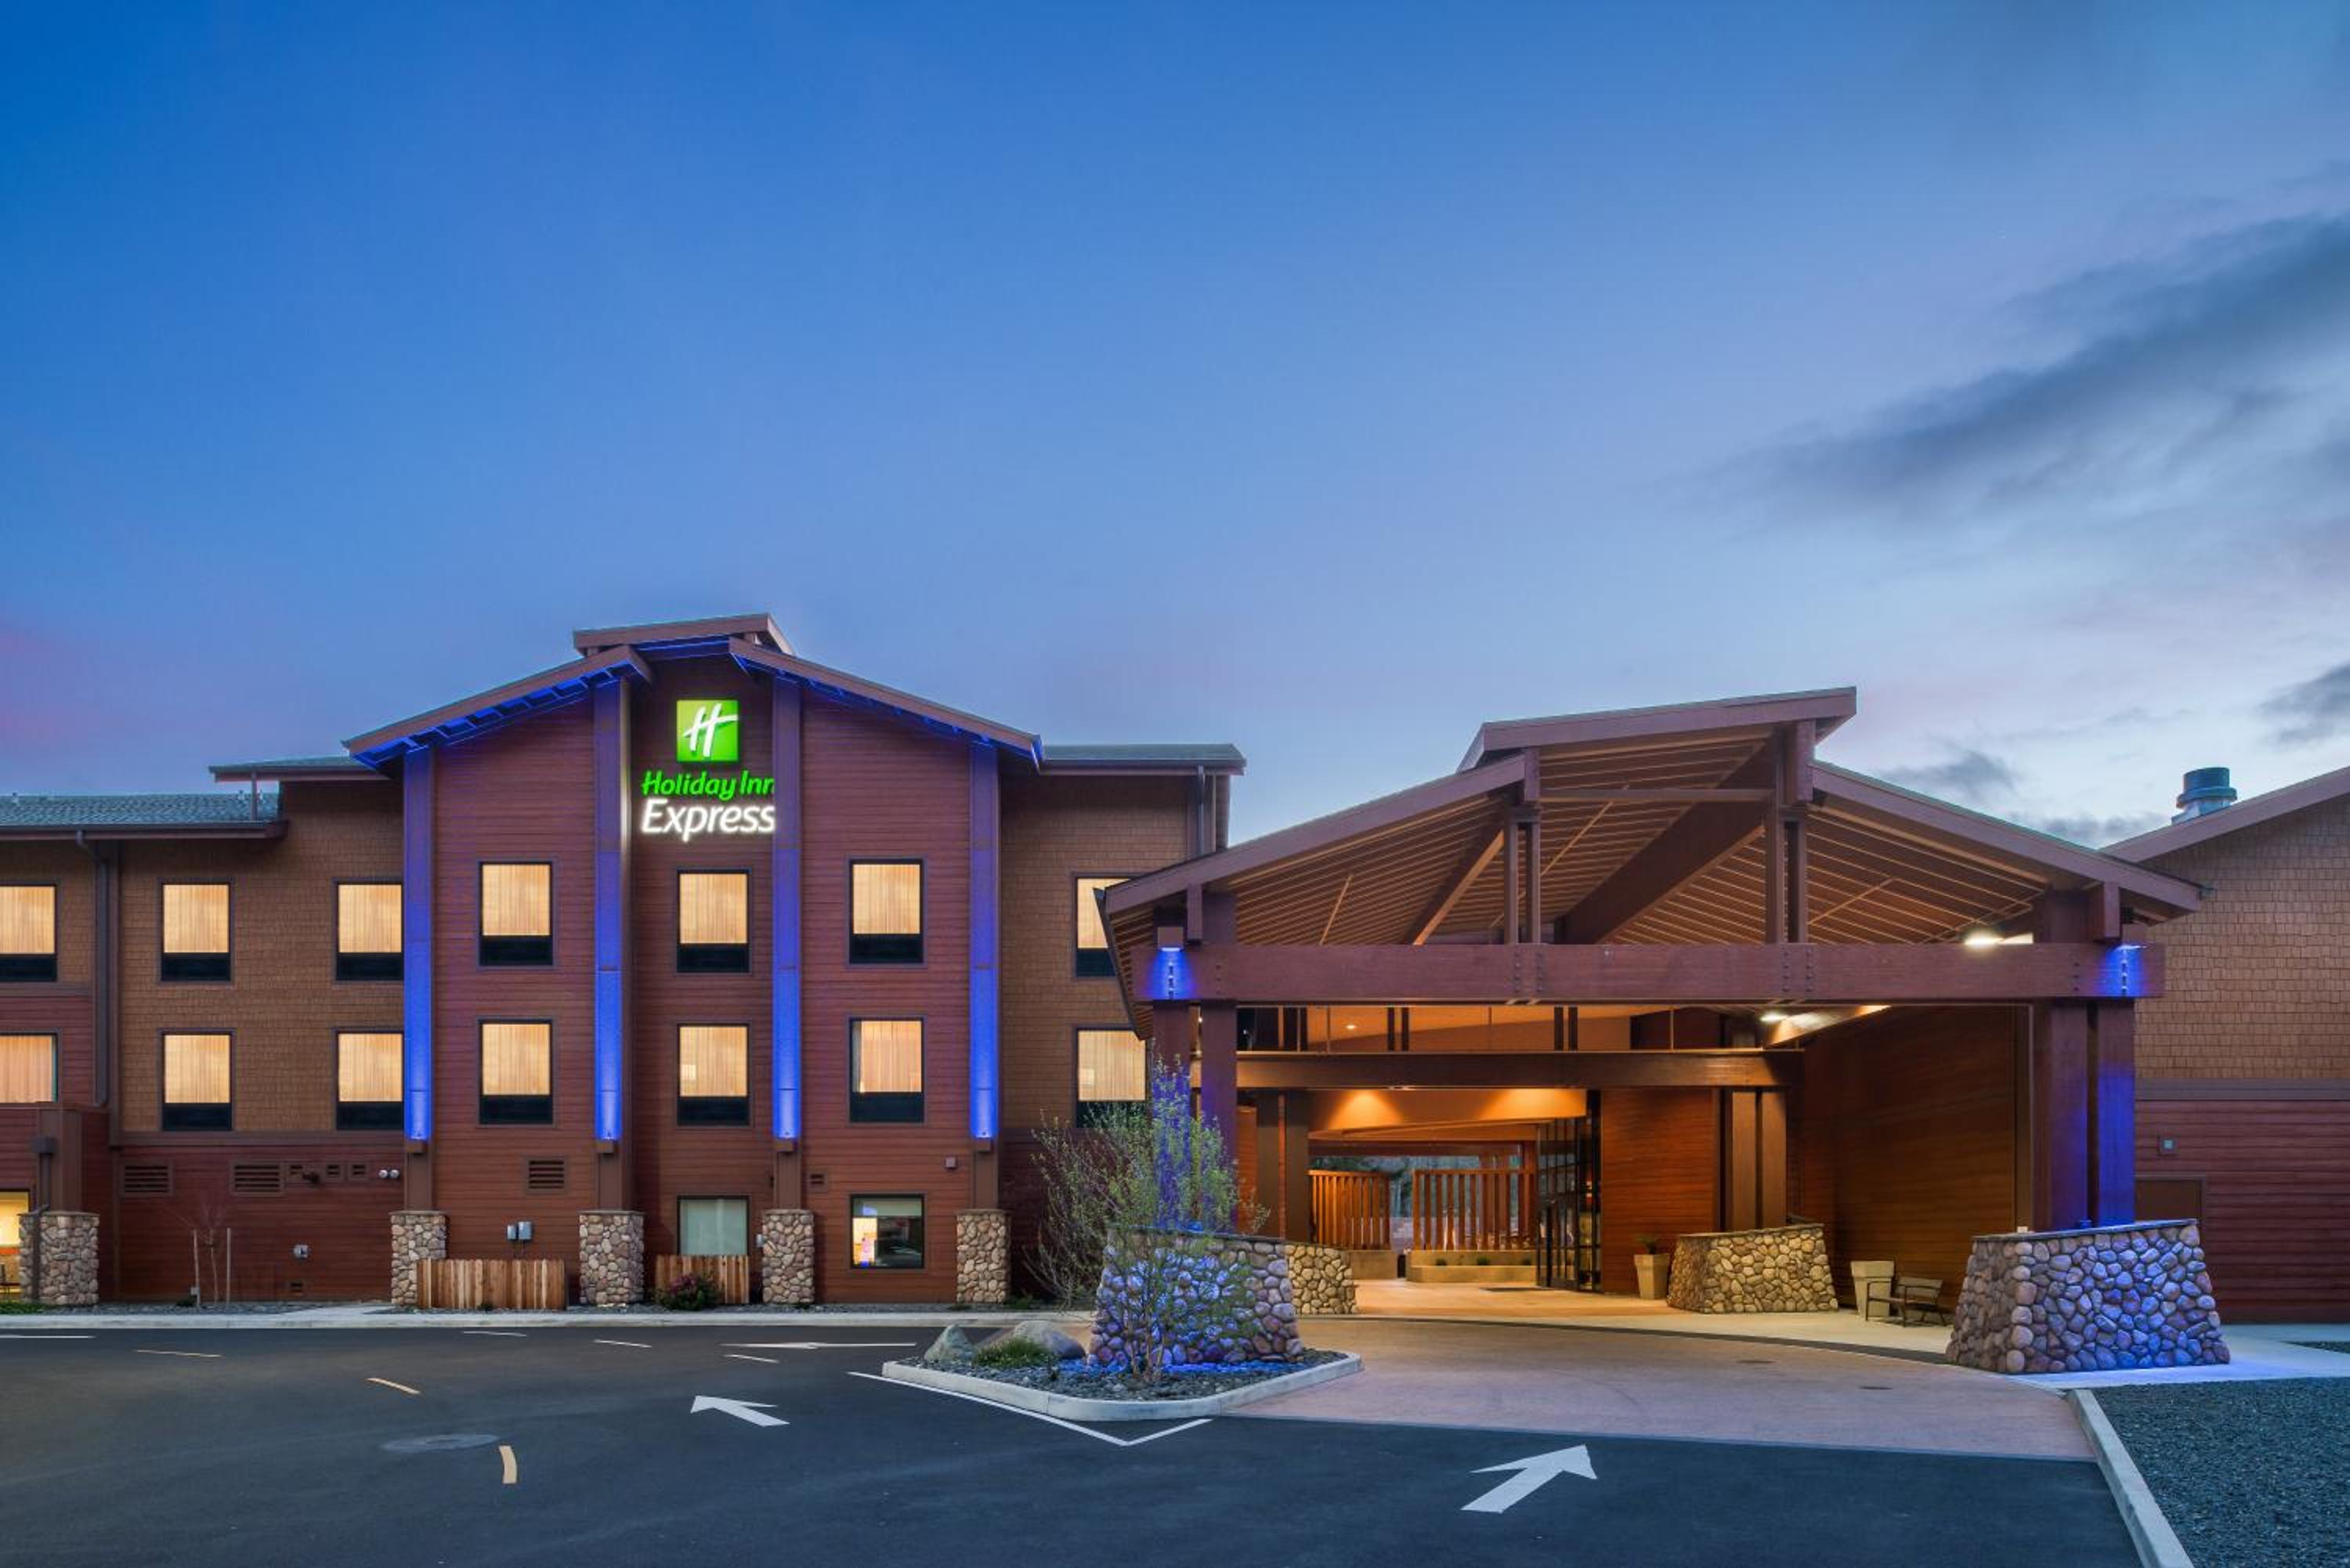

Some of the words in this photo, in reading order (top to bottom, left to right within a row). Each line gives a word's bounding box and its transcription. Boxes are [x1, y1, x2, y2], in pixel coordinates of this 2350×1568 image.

[683, 703, 739, 757] H
[642, 771, 737, 800] Holiday
[739, 771, 775, 795] Inn
[641, 798, 776, 843] Express
